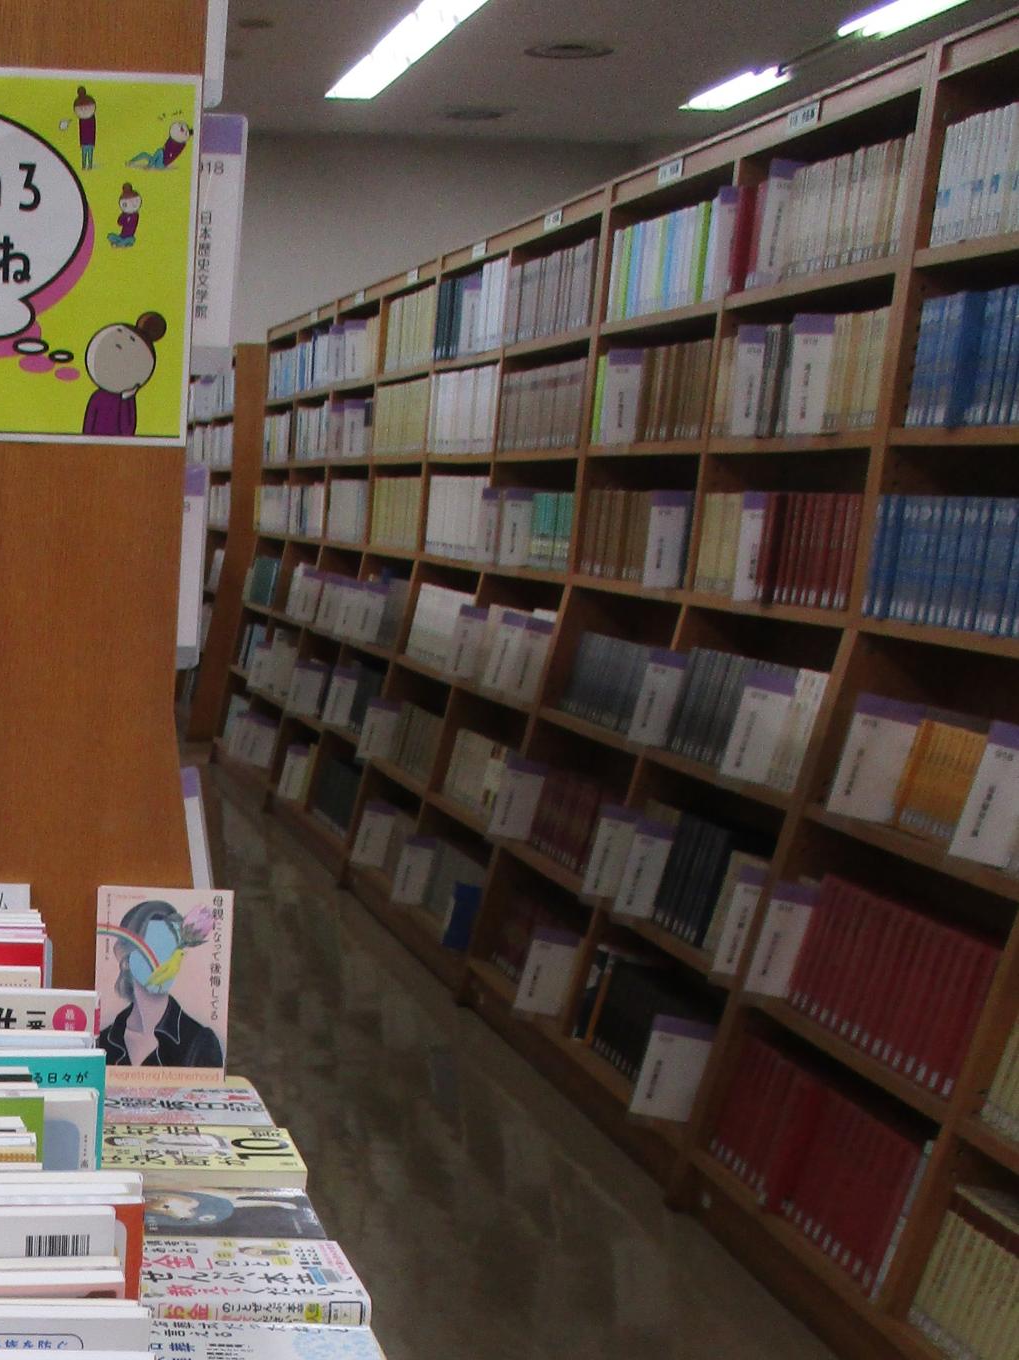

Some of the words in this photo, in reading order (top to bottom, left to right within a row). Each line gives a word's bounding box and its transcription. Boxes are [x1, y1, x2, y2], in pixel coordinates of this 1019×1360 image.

[209, 895, 224, 1021] 母親になって後悔してる
